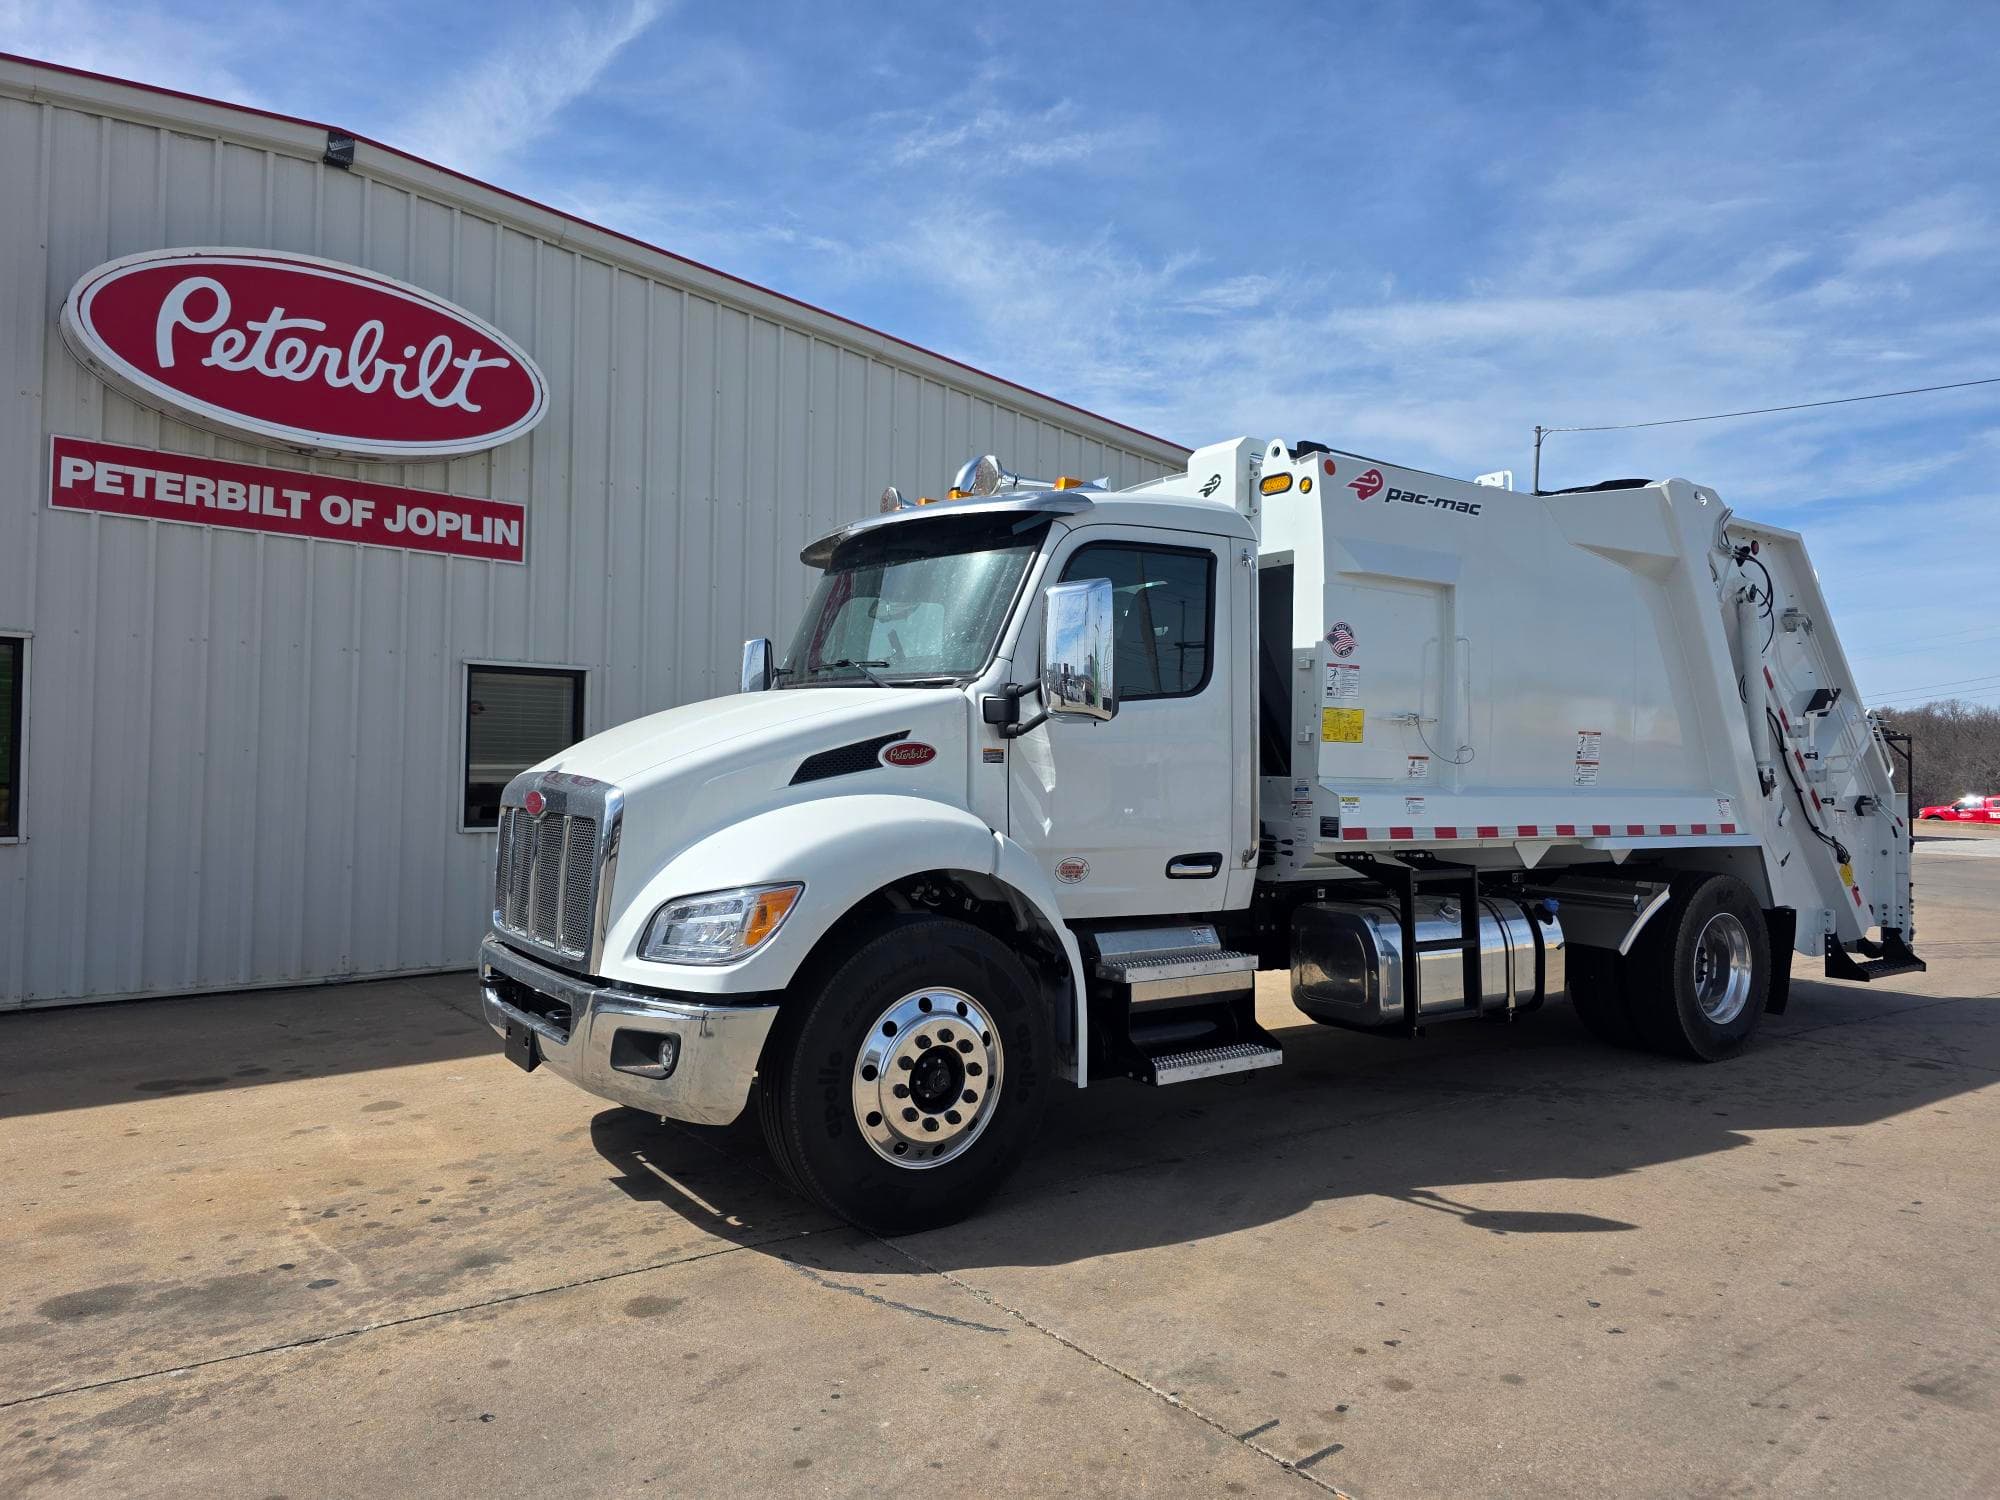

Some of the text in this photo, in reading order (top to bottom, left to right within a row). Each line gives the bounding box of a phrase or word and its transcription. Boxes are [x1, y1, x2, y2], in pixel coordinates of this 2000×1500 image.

[155, 276, 511, 412] Peterbilt
[59, 455, 520, 548] PETERBILT OF JOPLIN
[1384, 487, 1482, 517] pac-mac
[890, 747, 932, 761] Peterbilt
